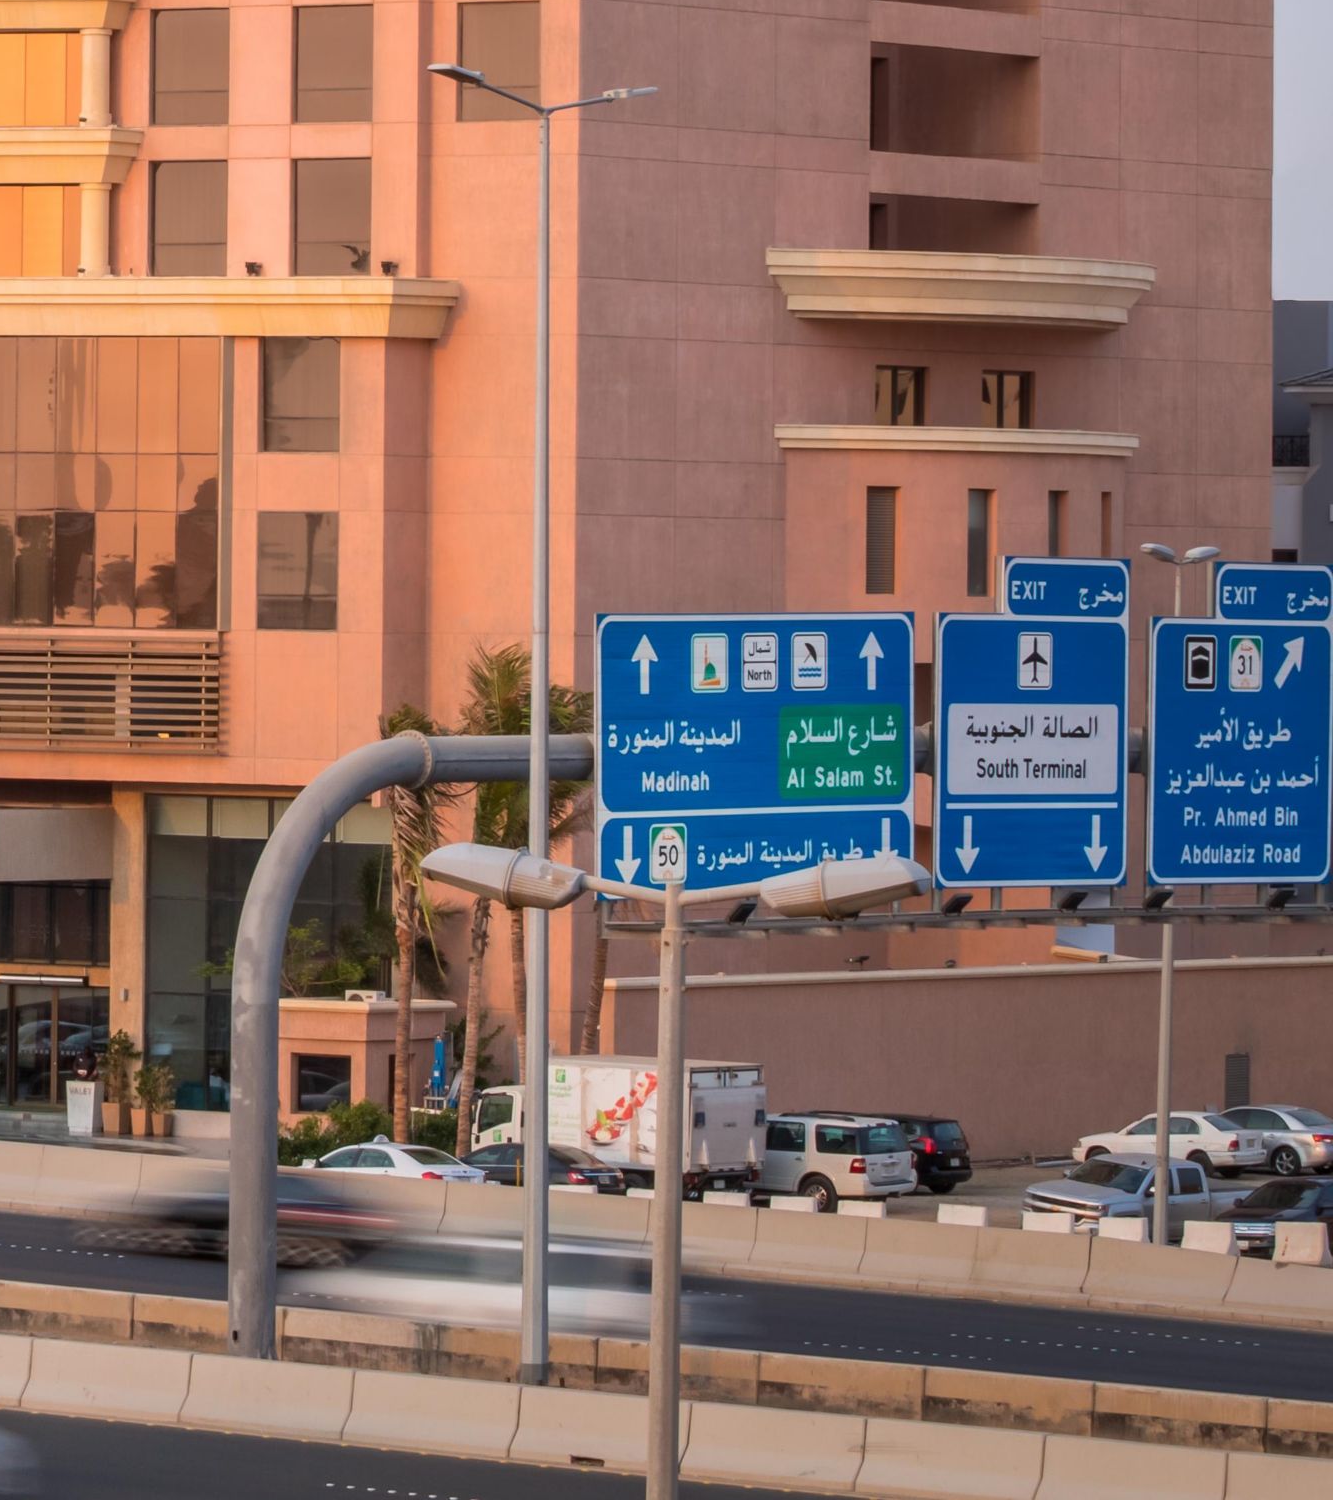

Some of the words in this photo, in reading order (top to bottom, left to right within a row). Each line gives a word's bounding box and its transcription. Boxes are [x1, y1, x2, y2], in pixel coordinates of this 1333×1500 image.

[1011, 581, 1047, 600] EXIT
[1079, 583, 1124, 610] مخرج
[1222, 586, 1257, 605] EXIT
[1286, 587, 1329, 614] مخرج
[748, 641, 771, 657] شمال
[747, 669, 772, 681] North
[1237, 655, 1253, 675] 31
[608, 719, 674, 755] المنورة
[679, 718, 741, 753] المدينة
[786, 717, 843, 758] السلام
[848, 715, 897, 756] شارع
[966, 715, 1034, 744] الجنوبية
[1042, 715, 1098, 738] الصالة
[1194, 707, 1239, 748] الأمير
[1242, 717, 1292, 750] طريق
[786, 768, 805, 789] Al
[814, 766, 864, 788] Salam
[873, 765, 897, 786] St.
[976, 758, 1019, 778] South
[1023, 758, 1086, 779] Terminal
[1250, 768, 1271, 794] بن
[1276, 755, 1320, 789] أحمد
[641, 770, 710, 793] Madinah
[1184, 807, 1206, 827] Pr.
[1214, 806, 1267, 827] Ahmed
[1274, 806, 1299, 826] Bin
[658, 844, 678, 867] 50
[696, 841, 753, 871] المنورة
[759, 839, 812, 869] المدينة
[1180, 844, 1255, 864] Abdulaziz
[1263, 843, 1301, 863] Road
[69, 1087, 92, 1096] VALET
